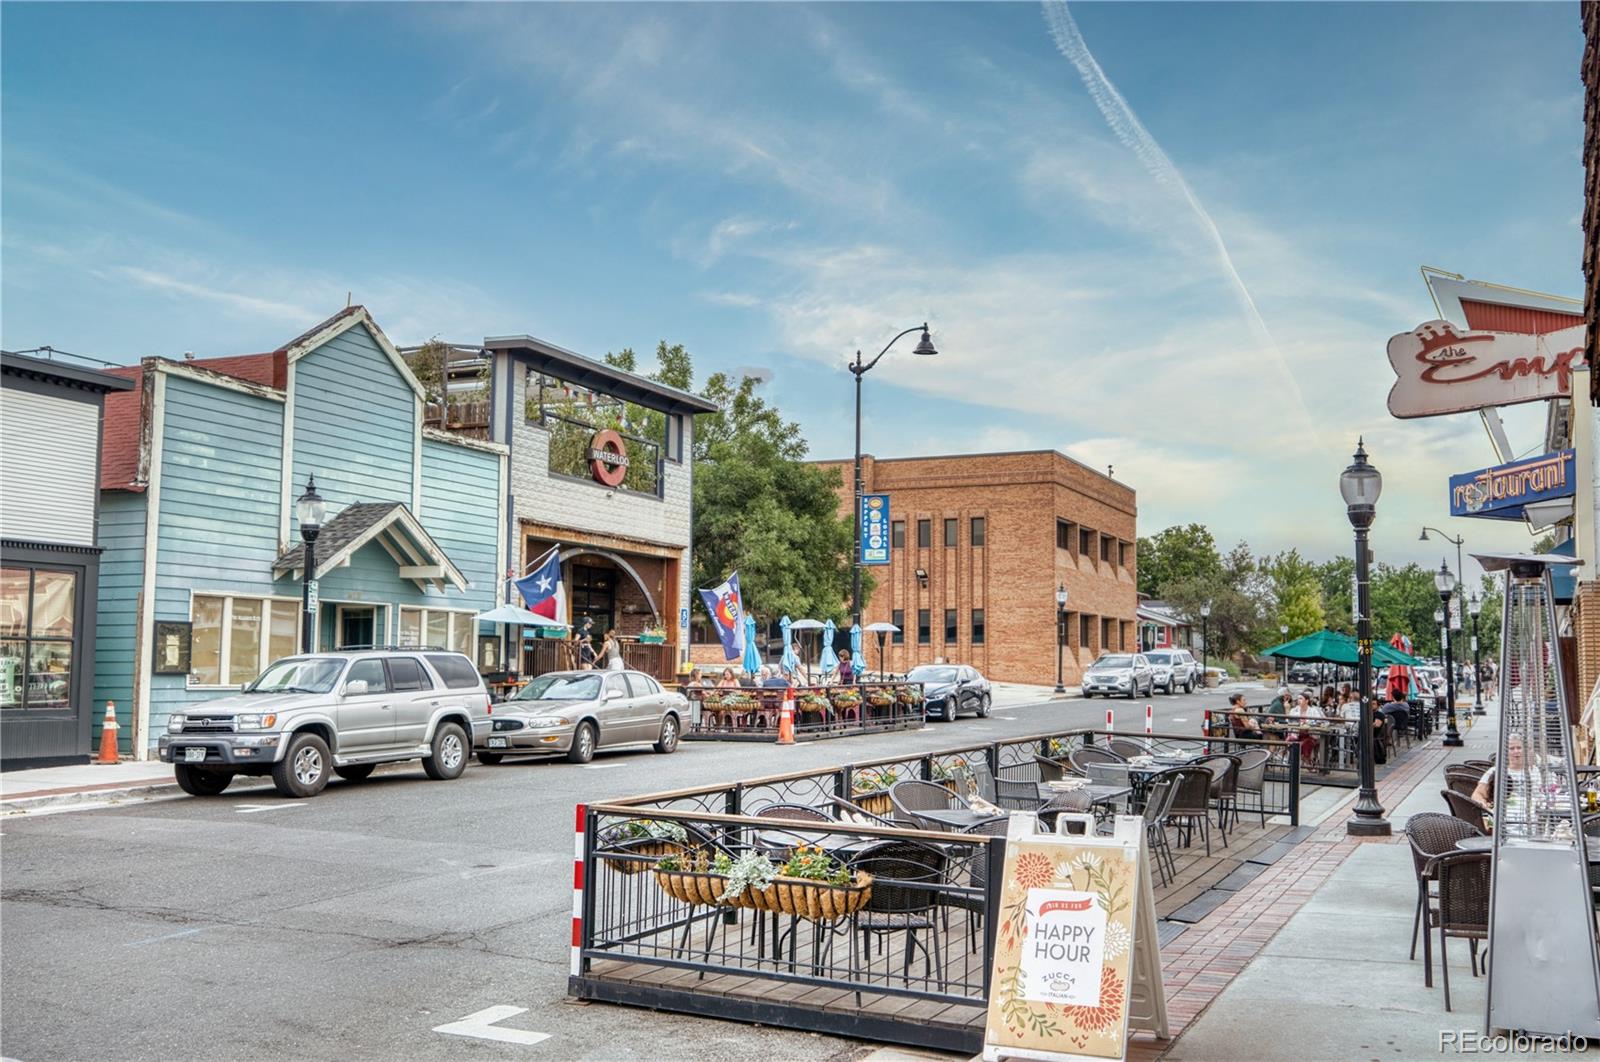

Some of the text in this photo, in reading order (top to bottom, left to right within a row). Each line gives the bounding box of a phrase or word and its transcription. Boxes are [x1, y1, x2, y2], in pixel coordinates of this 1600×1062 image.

[1438, 346, 1467, 357] the
[593, 449, 629, 466] WATERLOO
[1453, 453, 1573, 508] restaurant
[1035, 922, 1095, 943] HAPPY
[1034, 942, 1091, 963] HOUR
[1041, 971, 1076, 985] ZUCCA
